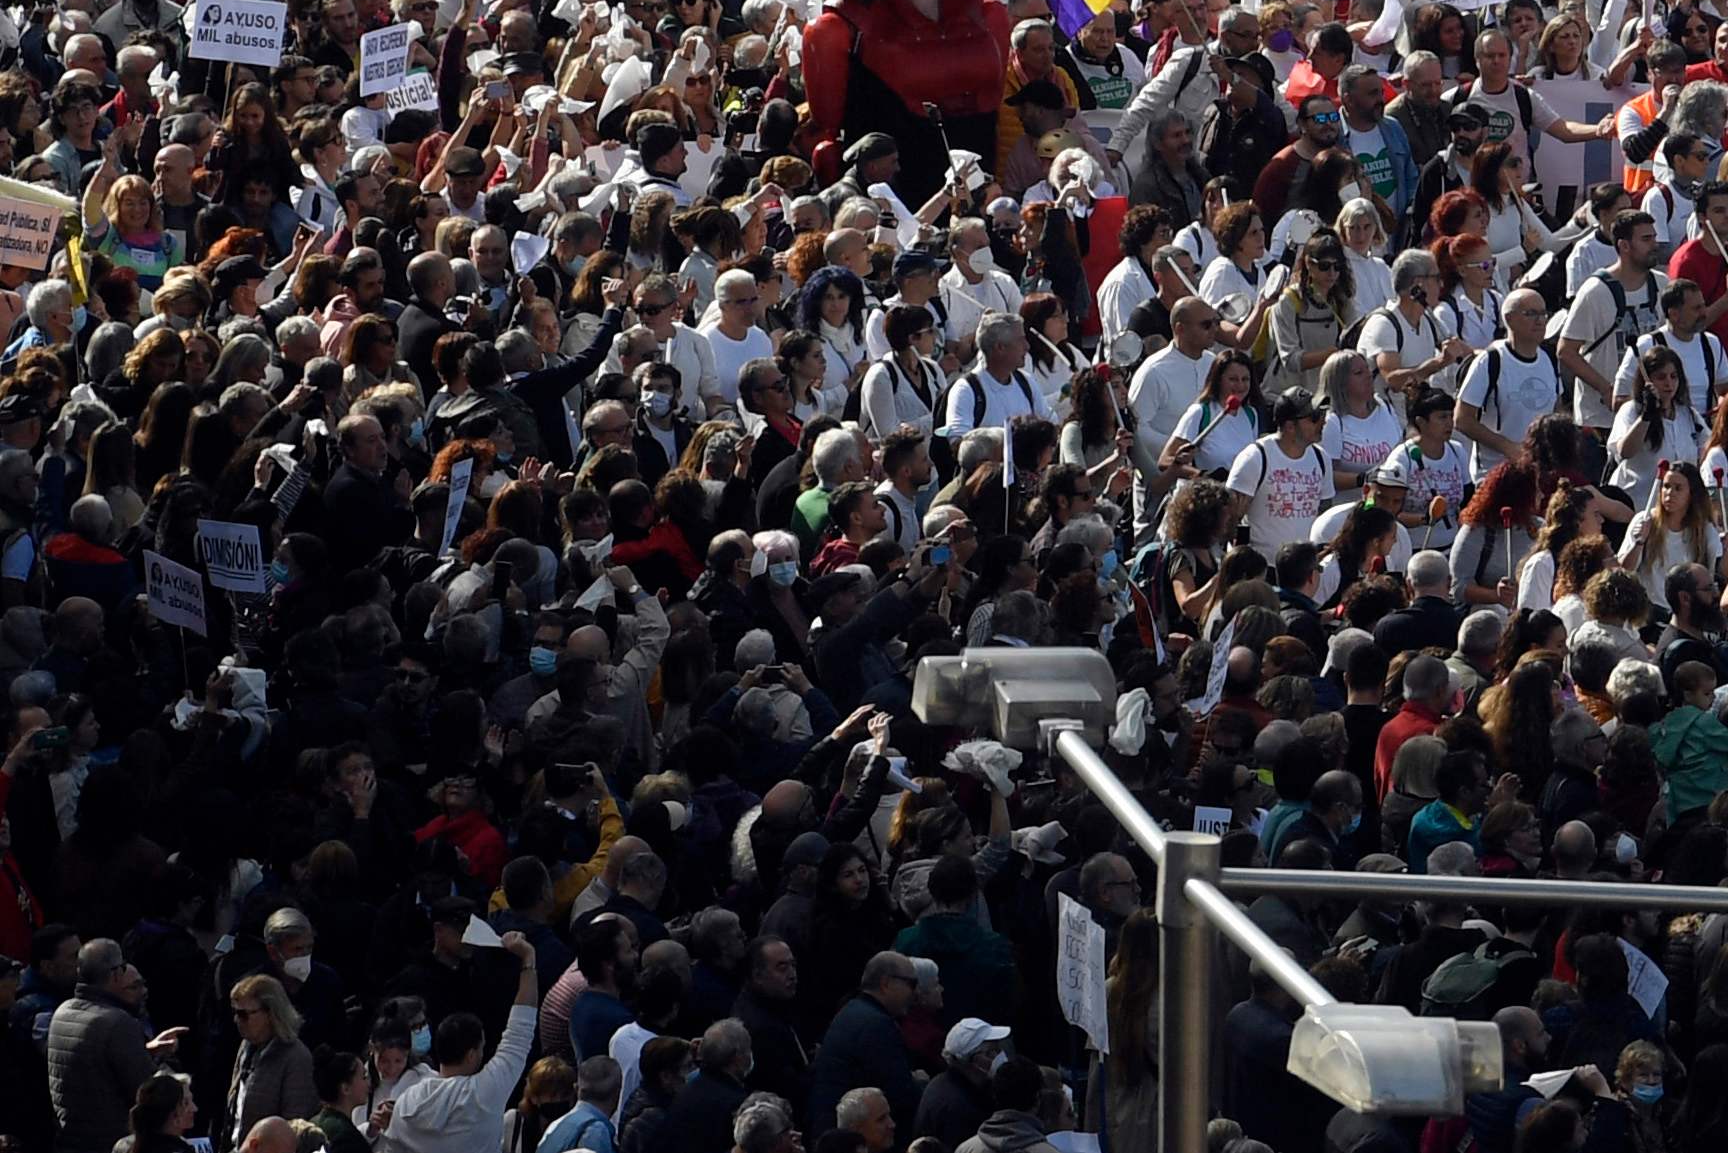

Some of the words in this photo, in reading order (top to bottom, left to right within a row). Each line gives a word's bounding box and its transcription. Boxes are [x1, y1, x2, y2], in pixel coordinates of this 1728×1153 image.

[224, 11, 279, 34] AYUSO,
[196, 28, 221, 44] MIL
[225, 33, 280, 51] abusos.
[202, 534, 260, 571] DIMISIÓN!
